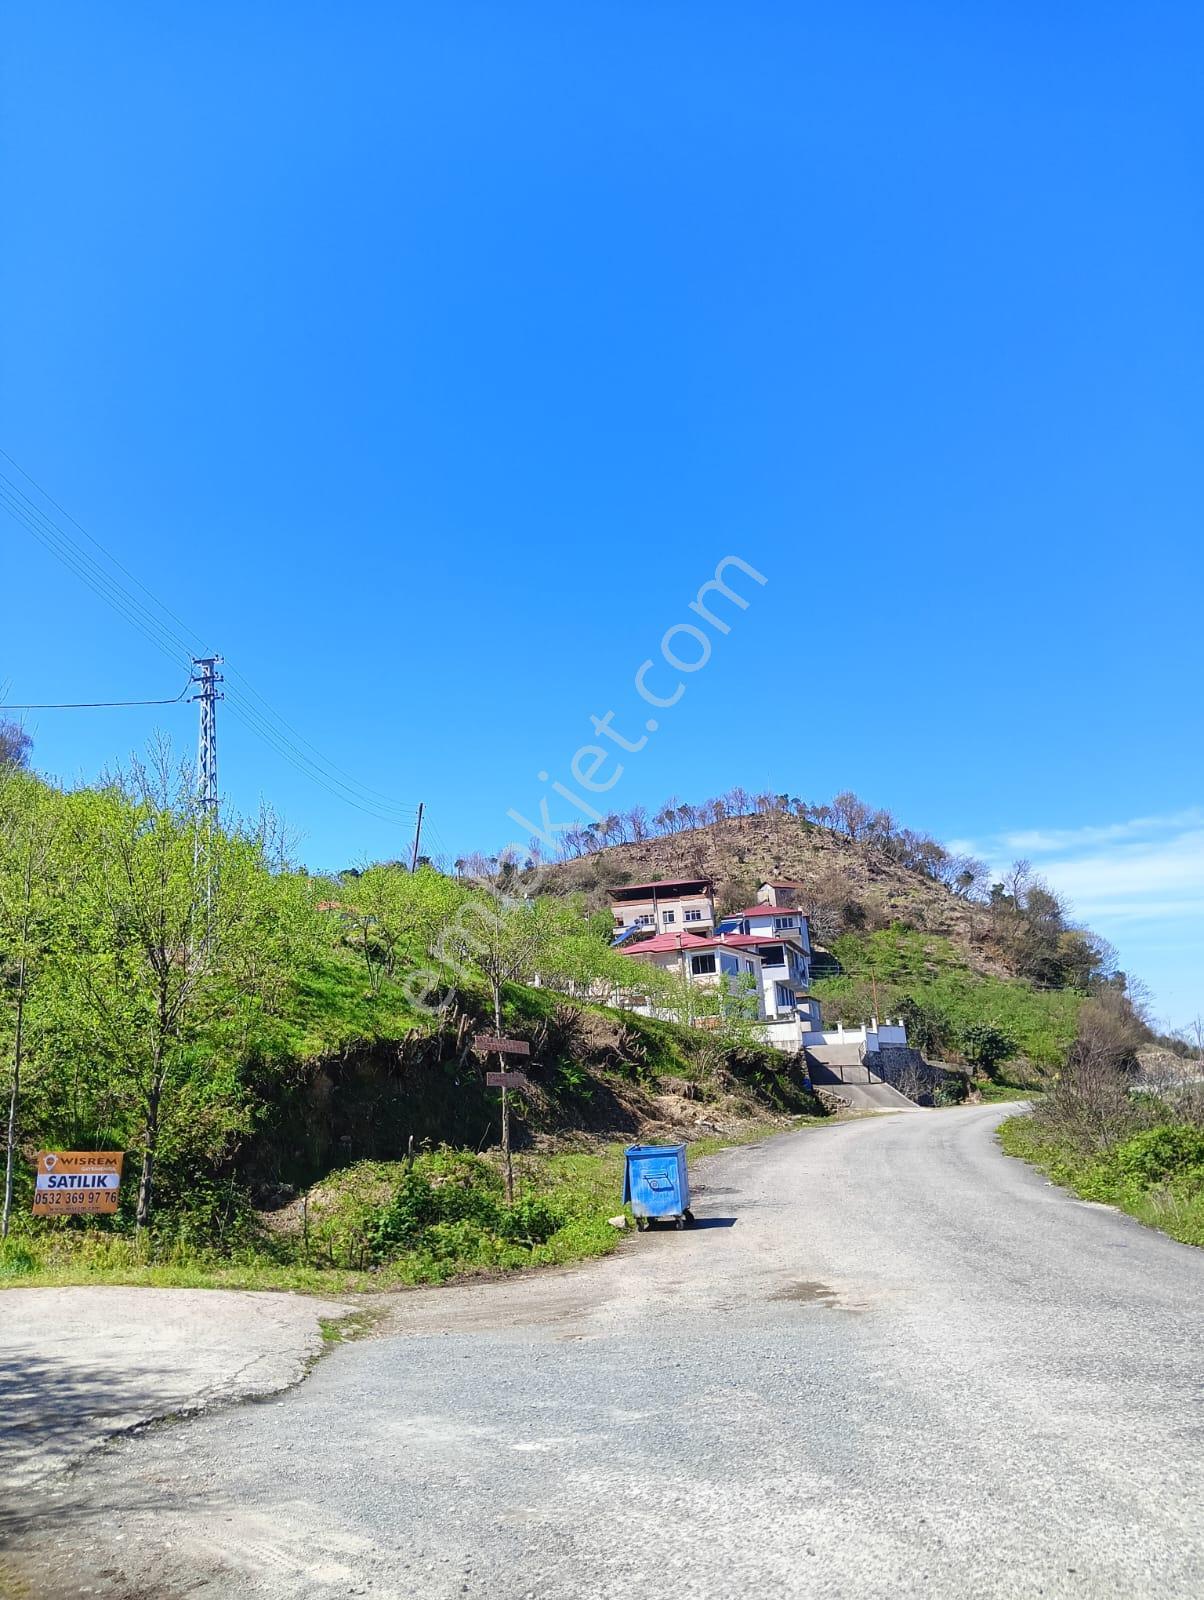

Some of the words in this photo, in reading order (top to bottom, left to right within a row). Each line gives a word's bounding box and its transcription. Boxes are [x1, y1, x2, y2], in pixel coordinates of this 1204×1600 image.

[60, 1157, 117, 1165] WISREM
[48, 1175, 108, 1188] SATILIK
[35, 1193, 61, 1205] 0532
[65, 1192, 85, 1204] 369
[88, 1192, 101, 1203] 97
[105, 1192, 117, 1203] 76
